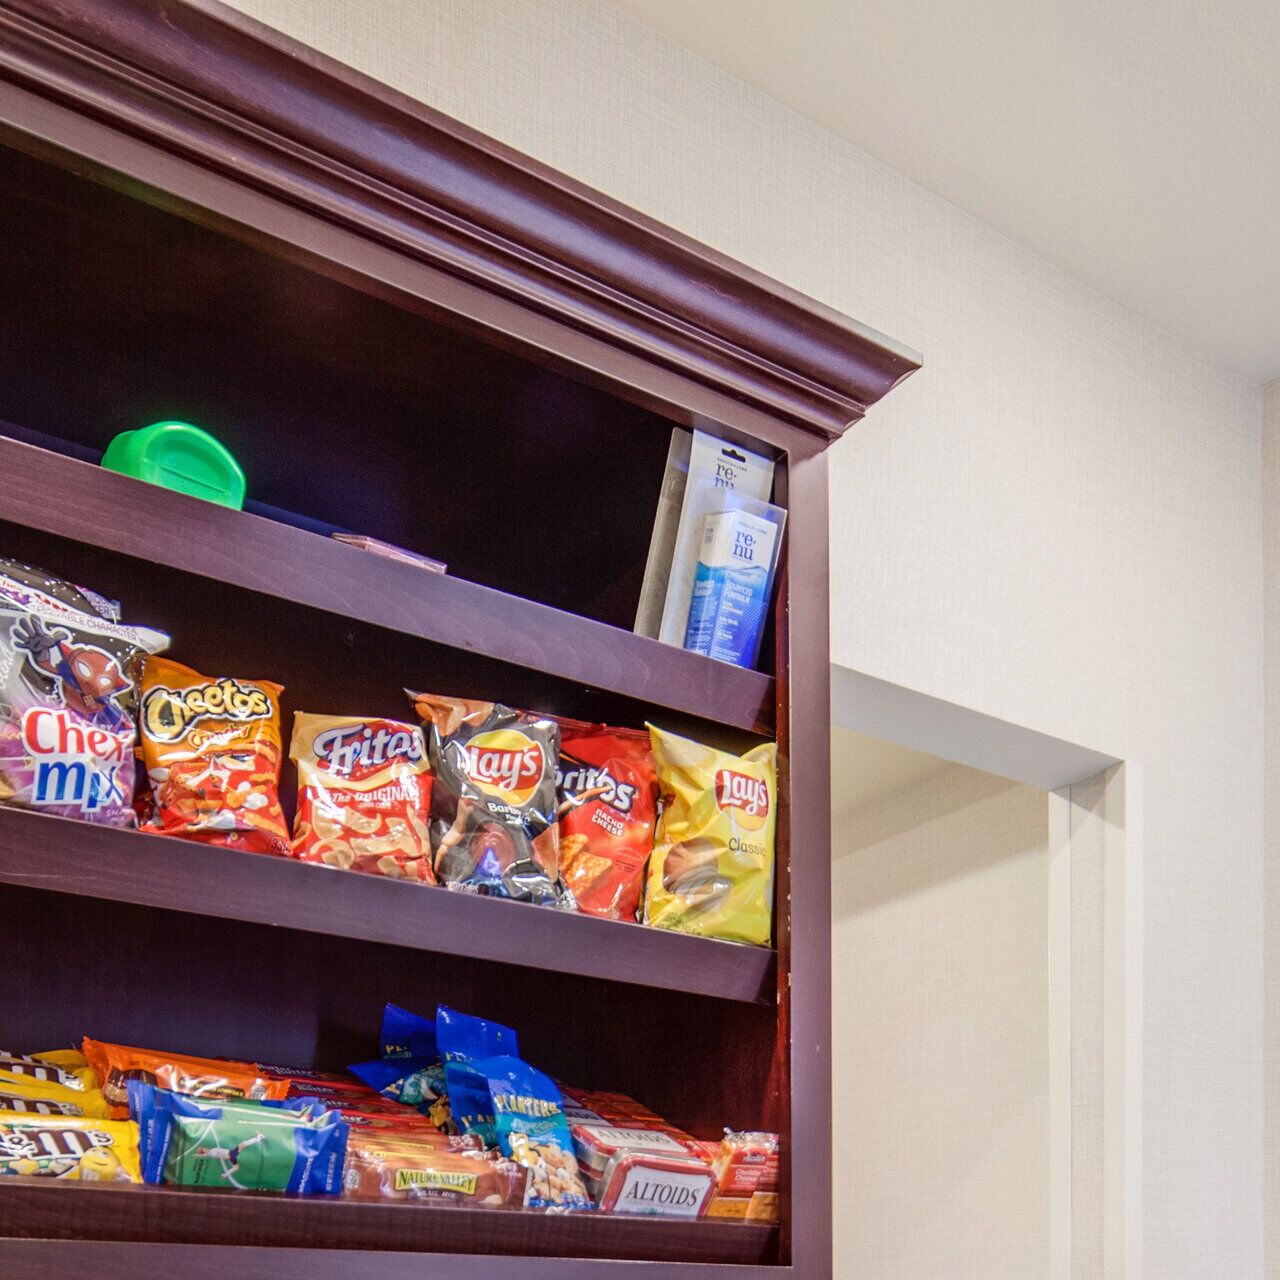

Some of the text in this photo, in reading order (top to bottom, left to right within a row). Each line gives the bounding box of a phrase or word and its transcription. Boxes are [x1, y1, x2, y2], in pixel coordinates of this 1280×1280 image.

[732, 543, 754, 561] nu
[86, 618, 138, 641] CHARACTER
[143, 677, 272, 742] Cheetos
[23, 708, 126, 763] Chex
[312, 723, 424, 777] Fritos
[466, 746, 539, 792] Lay's
[331, 786, 419, 803] The ORIGINA
[720, 769, 767, 816] Lay's
[591, 815, 624, 837] CHEESE
[595, 807, 624, 829] NACHO
[727, 836, 768, 858] Classic
[494, 1093, 562, 1118] PLANTERS
[399, 1170, 476, 1192] NATURE VALLEY
[625, 1180, 702, 1206] ALTOIDS
